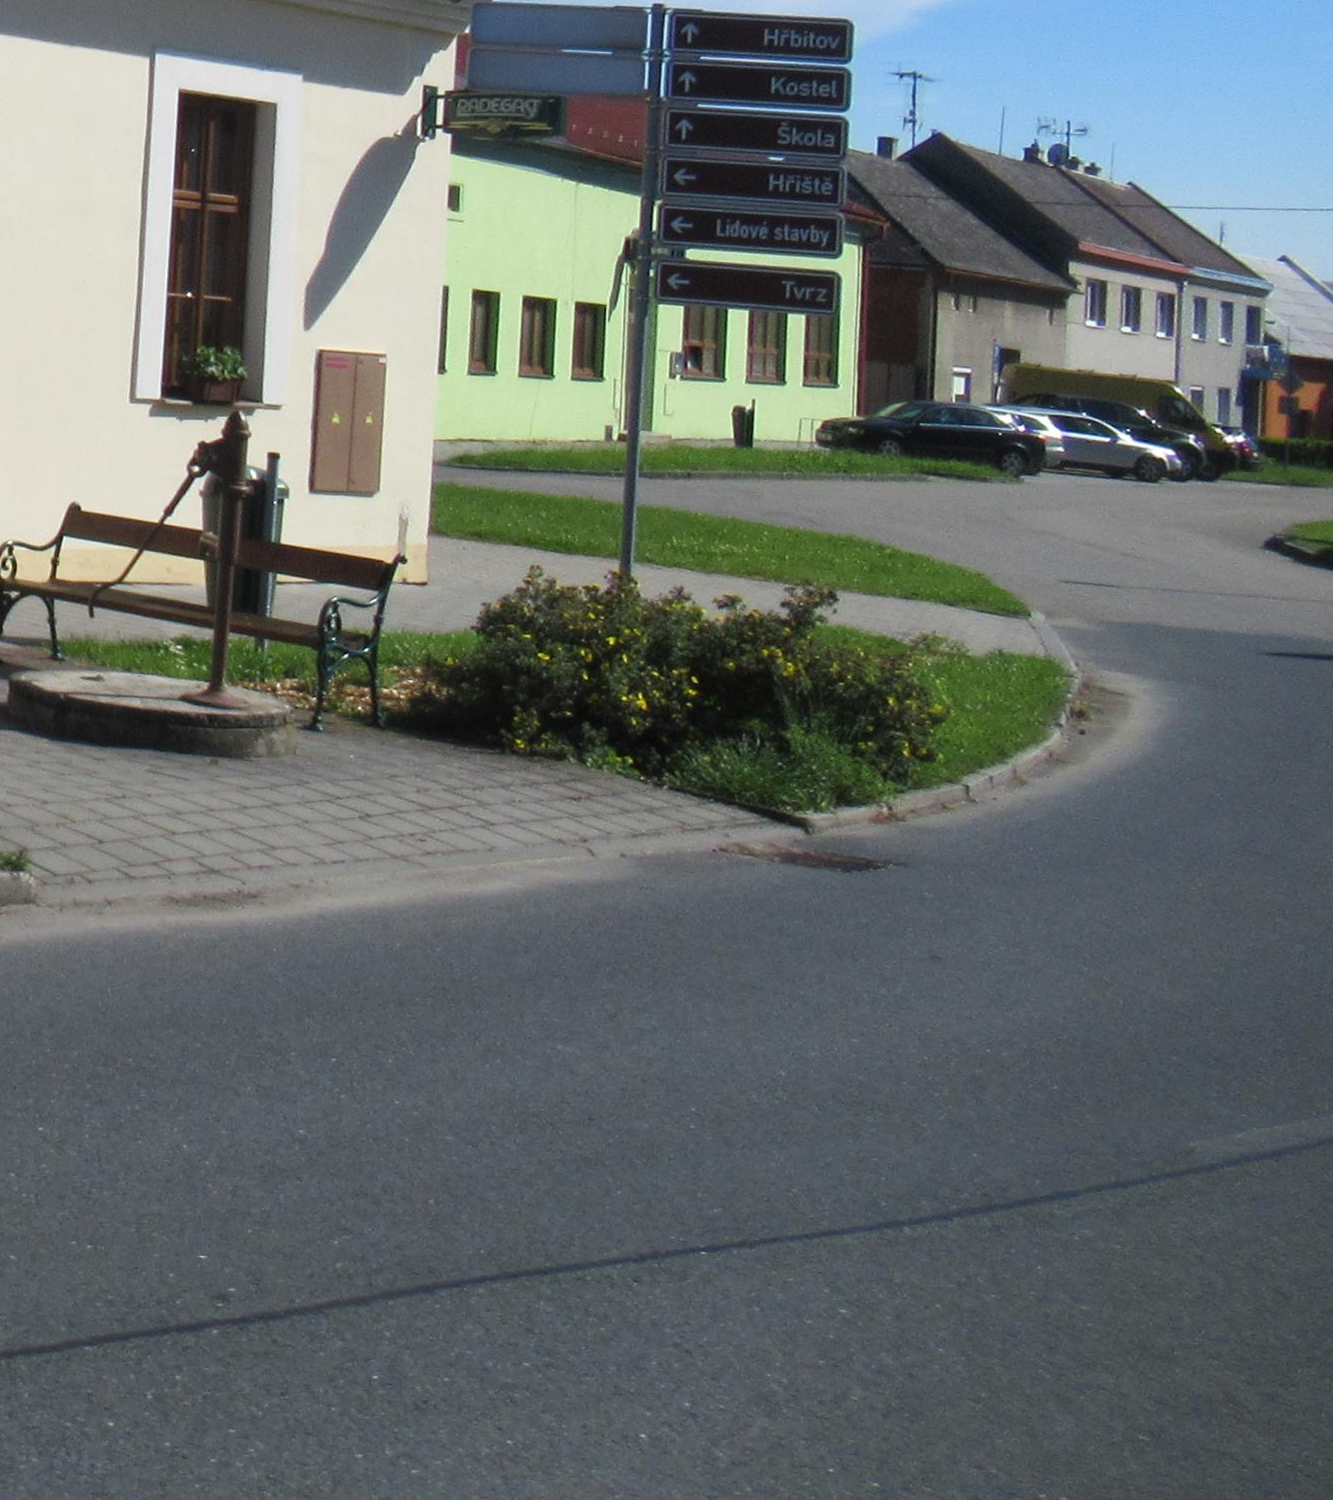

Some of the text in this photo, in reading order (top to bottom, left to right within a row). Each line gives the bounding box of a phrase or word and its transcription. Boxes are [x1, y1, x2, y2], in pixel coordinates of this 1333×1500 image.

[763, 28, 841, 49] Hřbitov
[770, 76, 837, 98] Kostel
[456, 98, 541, 118] RADEGAST
[777, 120, 834, 146] Škola
[768, 173, 833, 195] Hřiště
[716, 218, 830, 248] Lidové stavby
[782, 280, 827, 301] Tvrz
